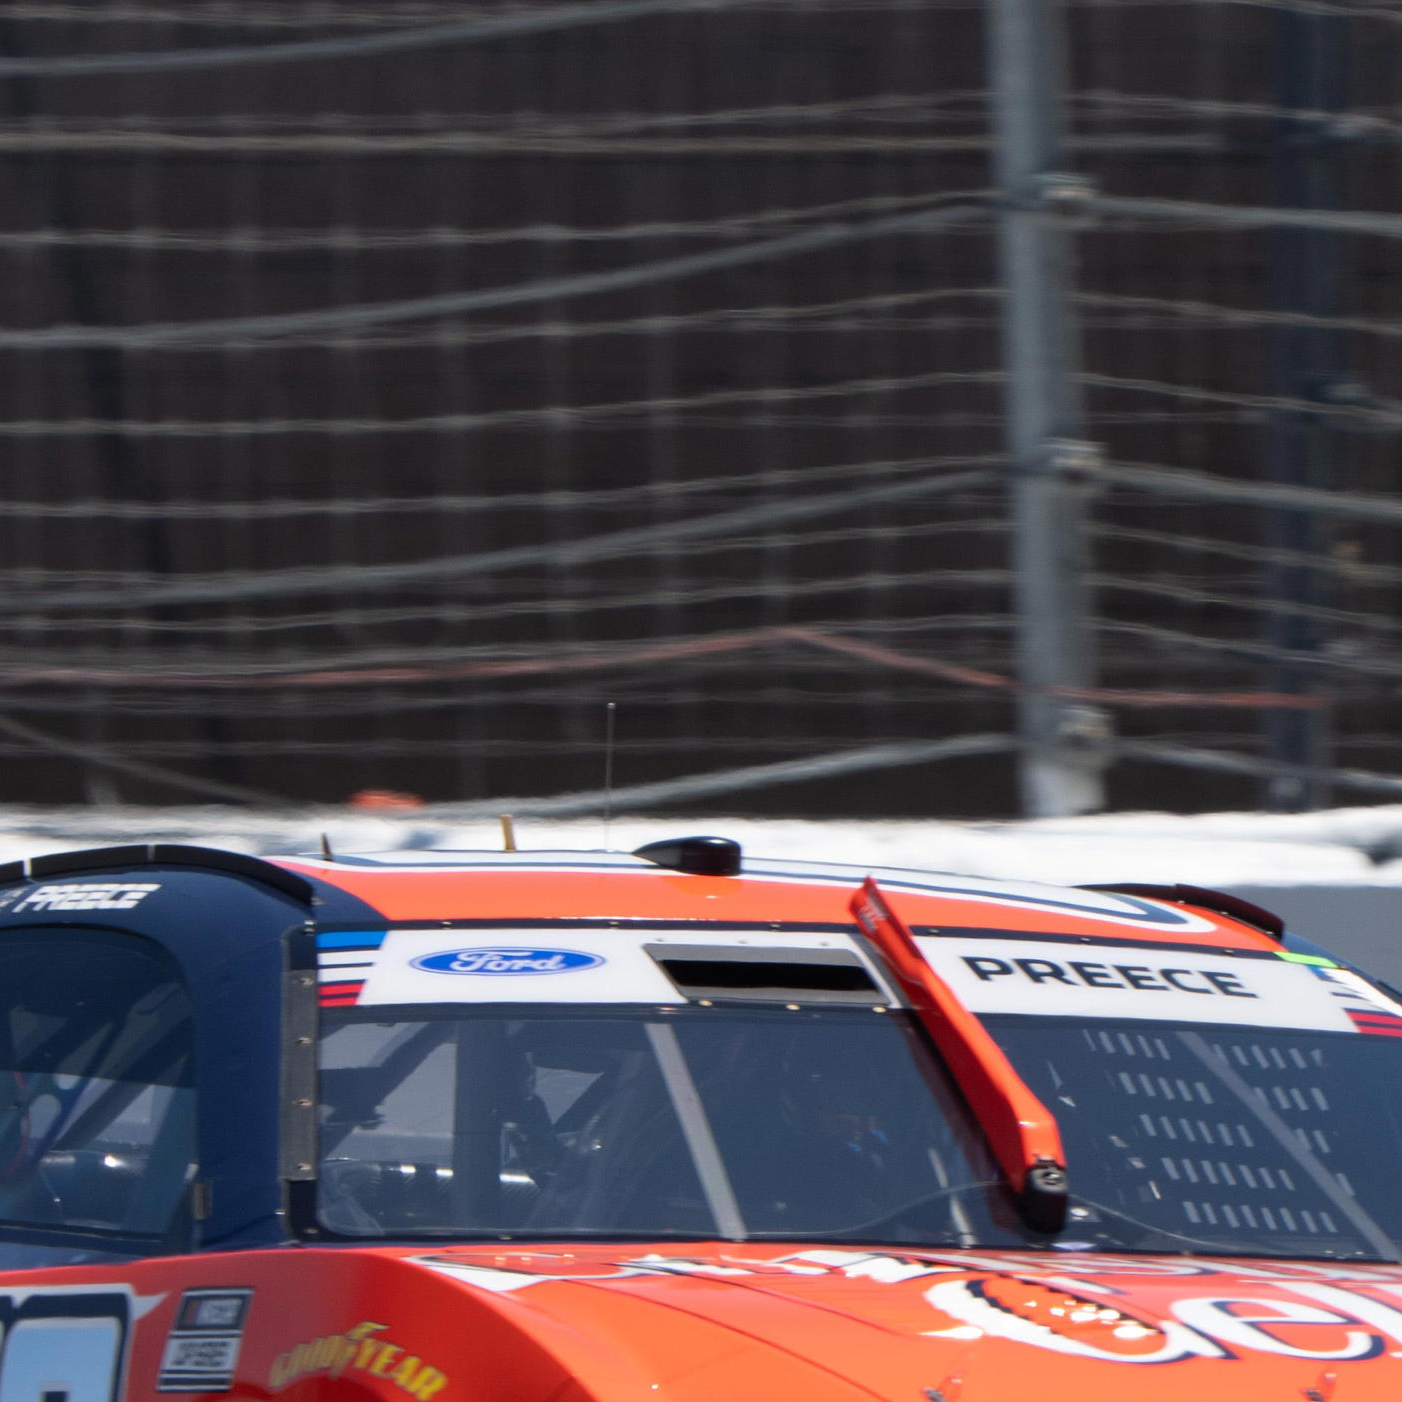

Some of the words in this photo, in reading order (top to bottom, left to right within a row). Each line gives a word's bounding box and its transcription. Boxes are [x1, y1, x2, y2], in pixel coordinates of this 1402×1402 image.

[449, 950, 567, 972] Ford
[960, 956, 1259, 999] PREECE
[269, 1321, 447, 1402] GOODYEAR
